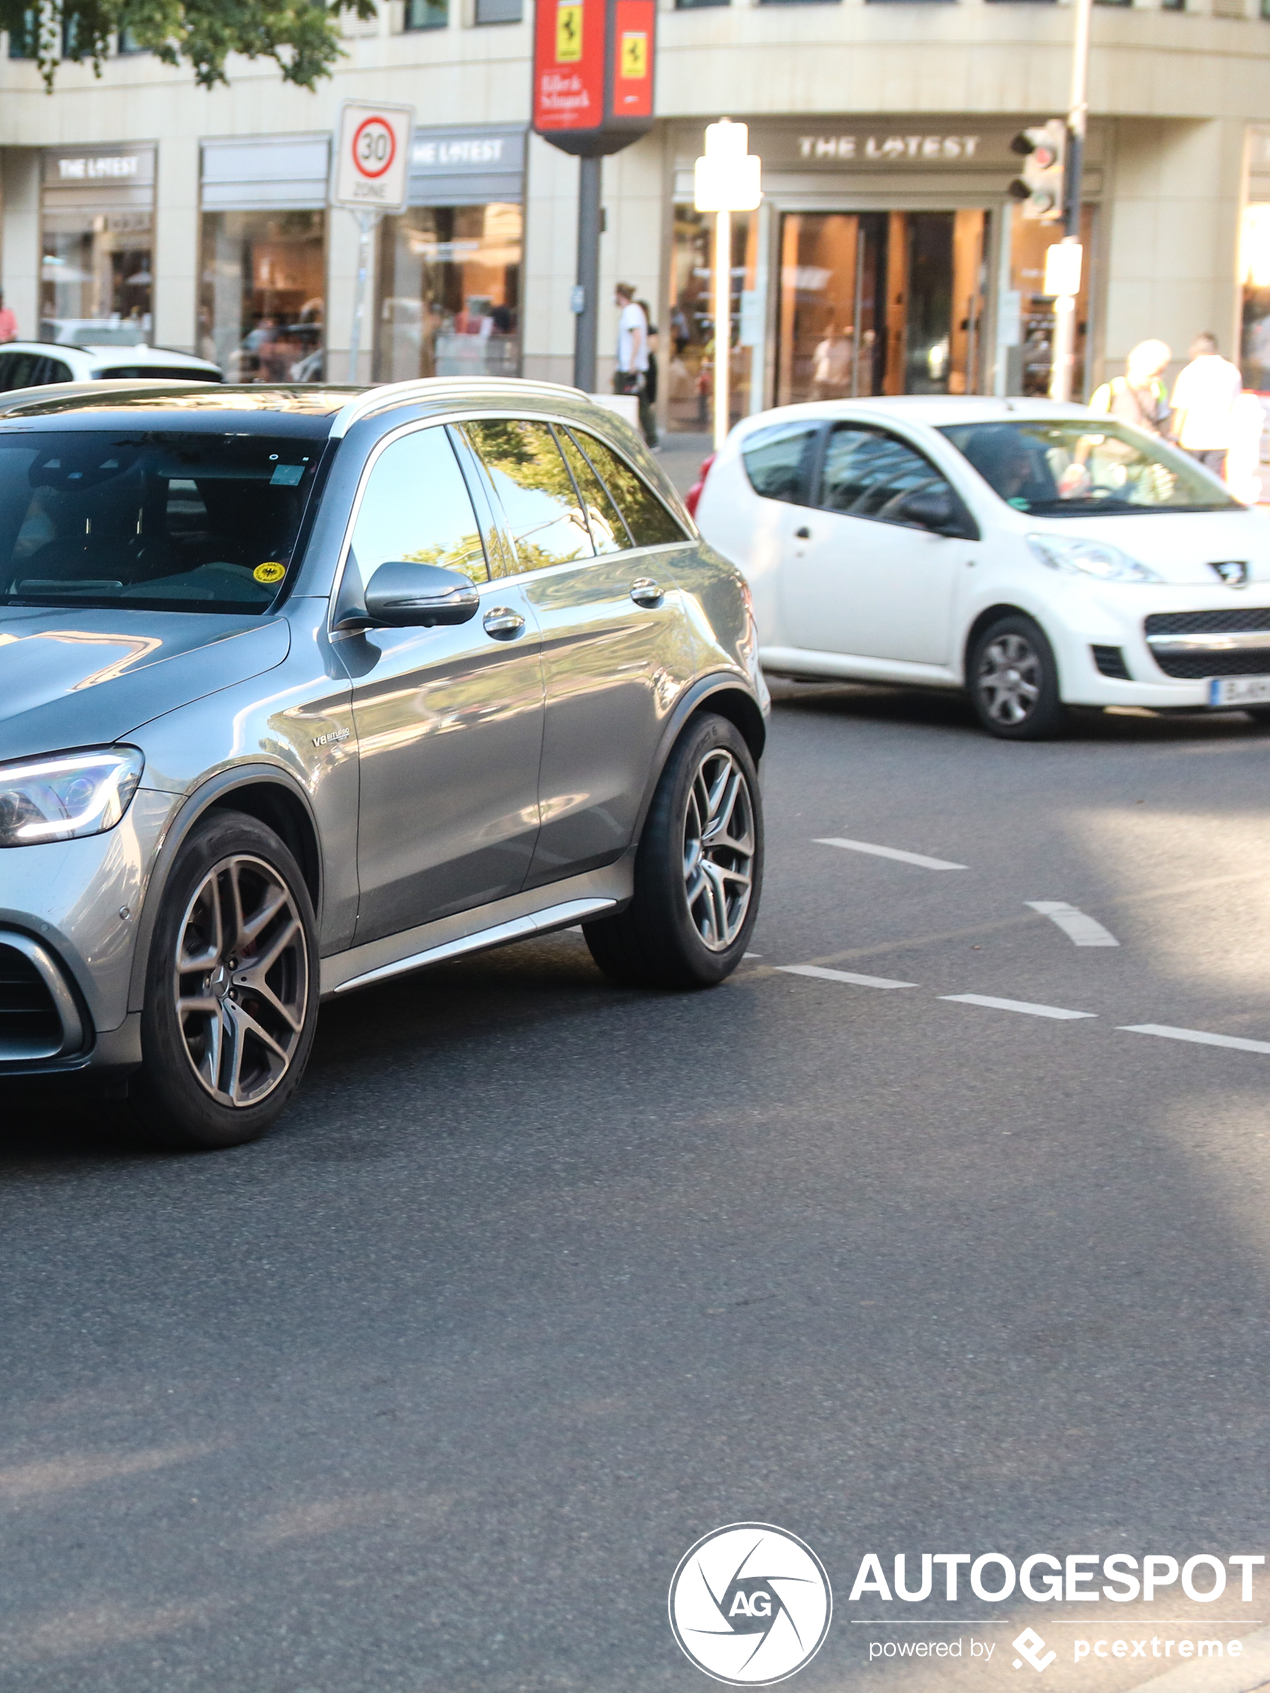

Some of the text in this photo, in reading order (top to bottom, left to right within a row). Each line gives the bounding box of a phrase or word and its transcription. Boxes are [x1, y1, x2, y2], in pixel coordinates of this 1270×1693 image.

[360, 132, 388, 161] 30
[412, 139, 504, 165] HE LATEST
[799, 135, 980, 158] THE LATEST
[59, 155, 137, 178] THE LATEST
[352, 181, 388, 198] ZONE
[312, 734, 328, 747] V8
